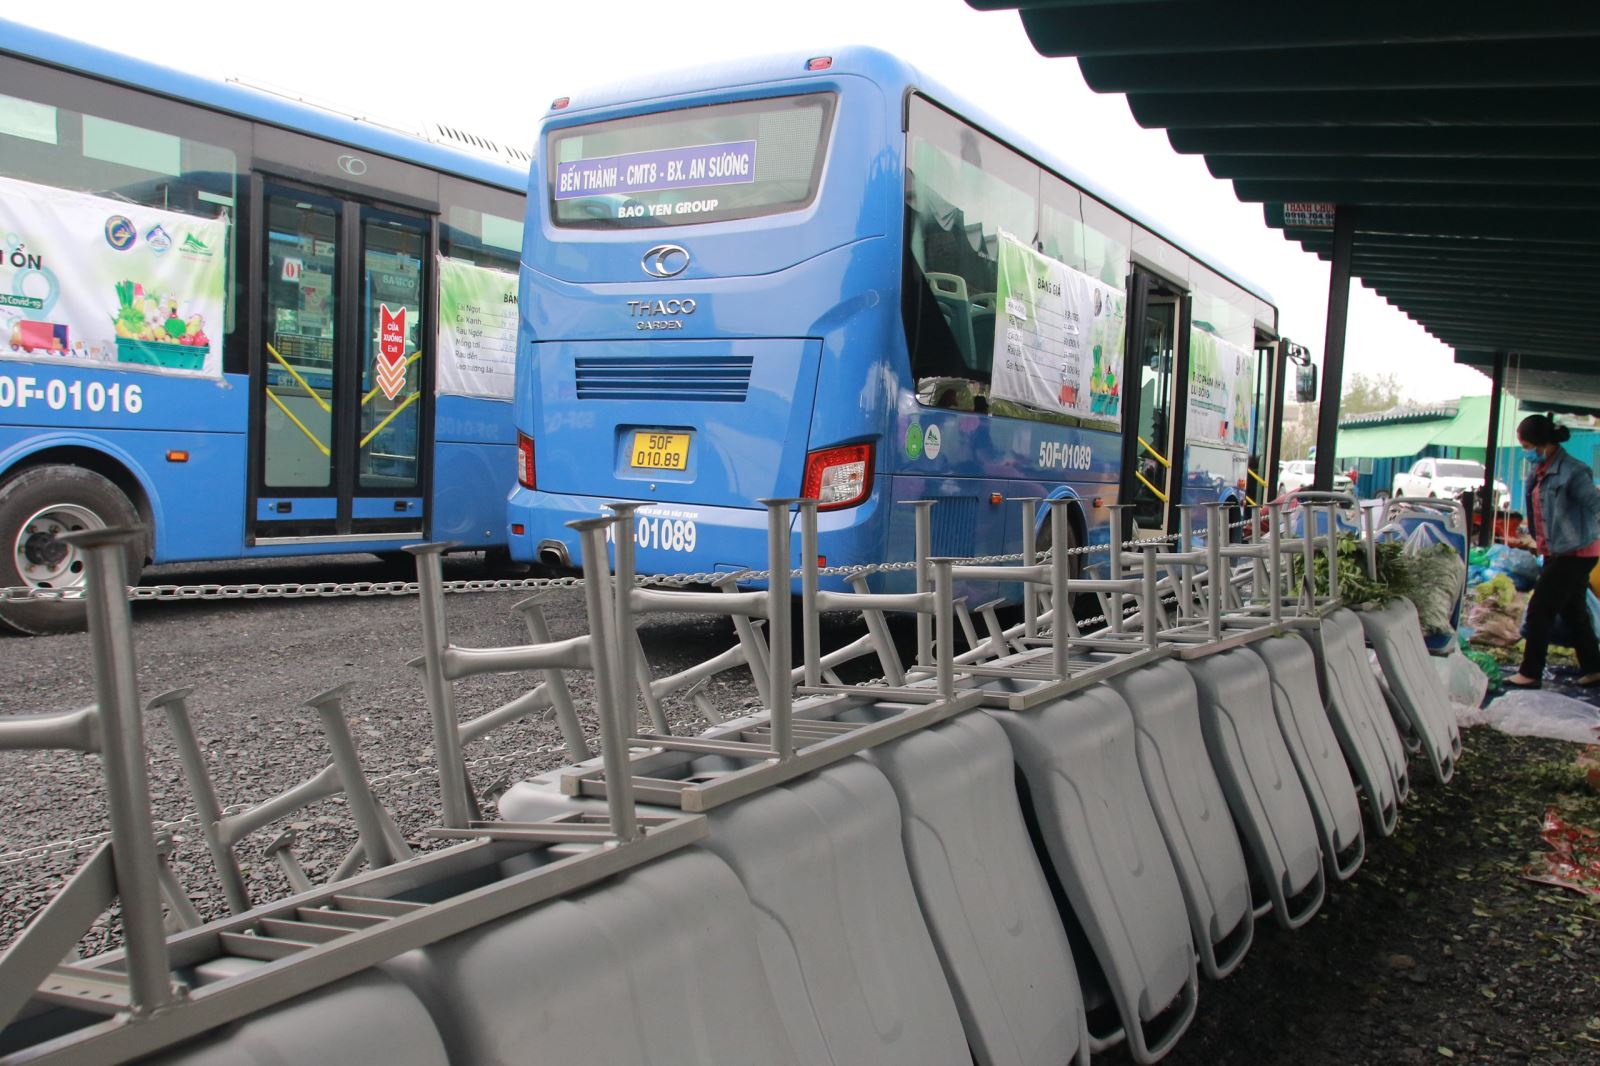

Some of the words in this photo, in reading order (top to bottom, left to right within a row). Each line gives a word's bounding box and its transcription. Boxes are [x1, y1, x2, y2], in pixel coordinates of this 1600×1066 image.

[559, 163, 581, 192] BẾN
[583, 164, 618, 189] THÀNH
[627, 163, 657, 186] CMT8
[667, 160, 686, 182] BX.
[689, 159, 706, 179] AN
[618, 203, 644, 218] BAO
[648, 203, 673, 216] YEN
[676, 199, 718, 214] GROUP
[10, 243, 42, 270] ỔN
[627, 298, 697, 317] THACO
[636, 320, 684, 331] GARDEN
[649, 435, 674, 450] 50F
[637, 451, 680, 467] 010.89
[1039, 441, 1092, 470] 50F-01089
